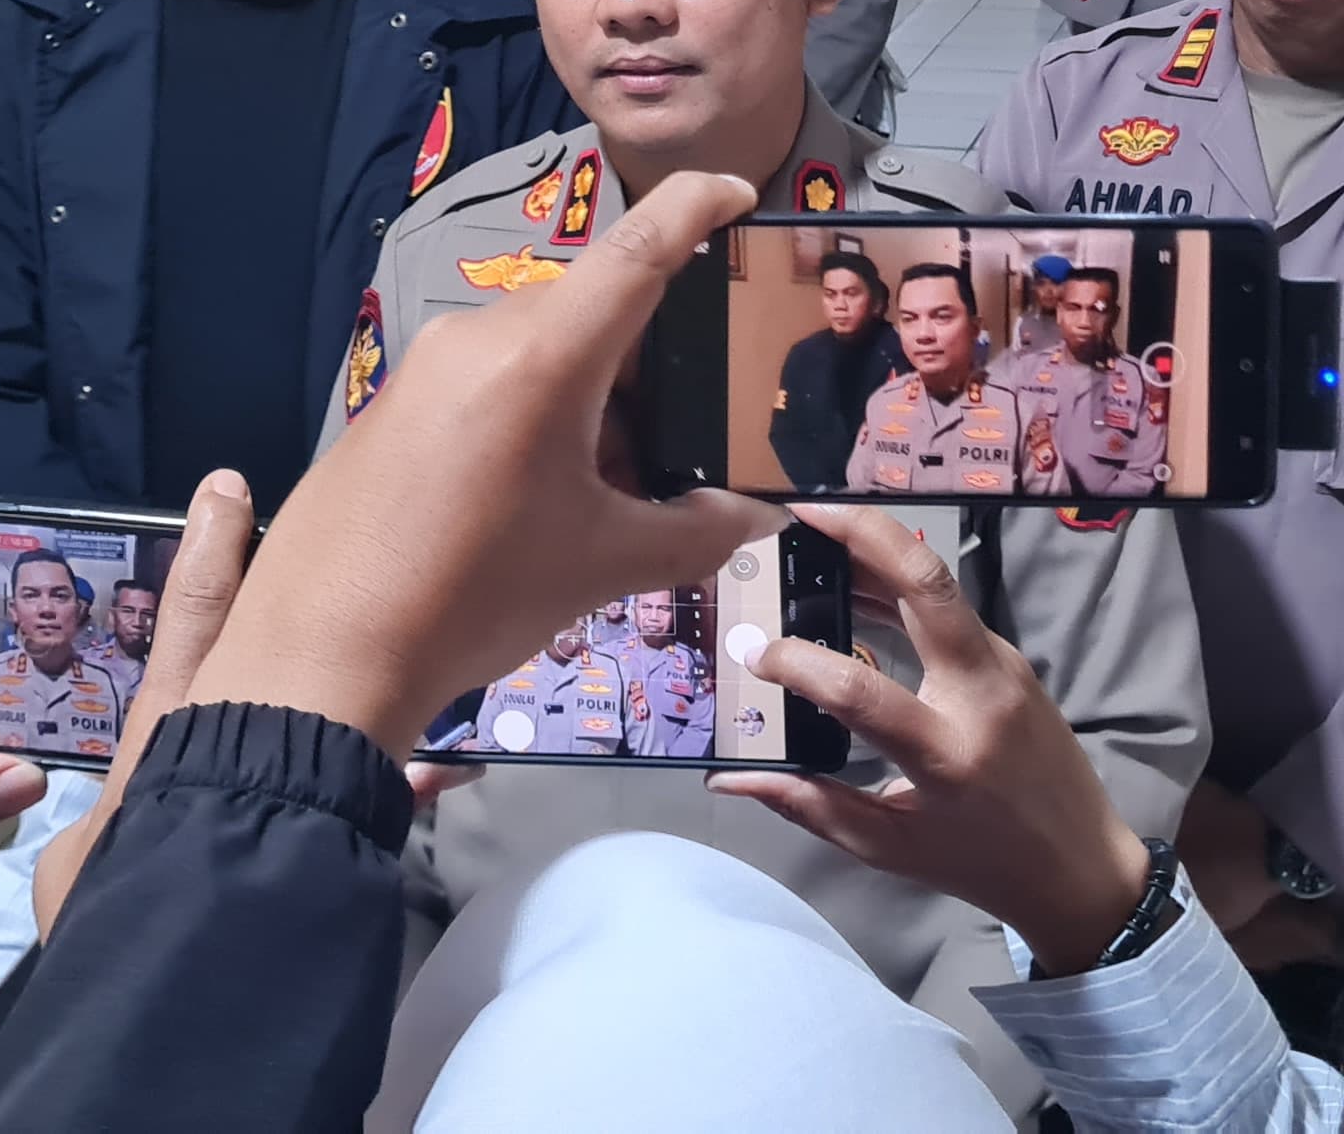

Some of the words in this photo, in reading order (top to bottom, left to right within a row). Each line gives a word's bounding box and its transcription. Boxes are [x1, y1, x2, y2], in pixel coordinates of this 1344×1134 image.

[1065, 177, 1193, 216] AHMAD
[959, 446, 1009, 462] POLRI
[577, 698, 616, 712] POLRI
[71, 716, 113, 732] POLRI
